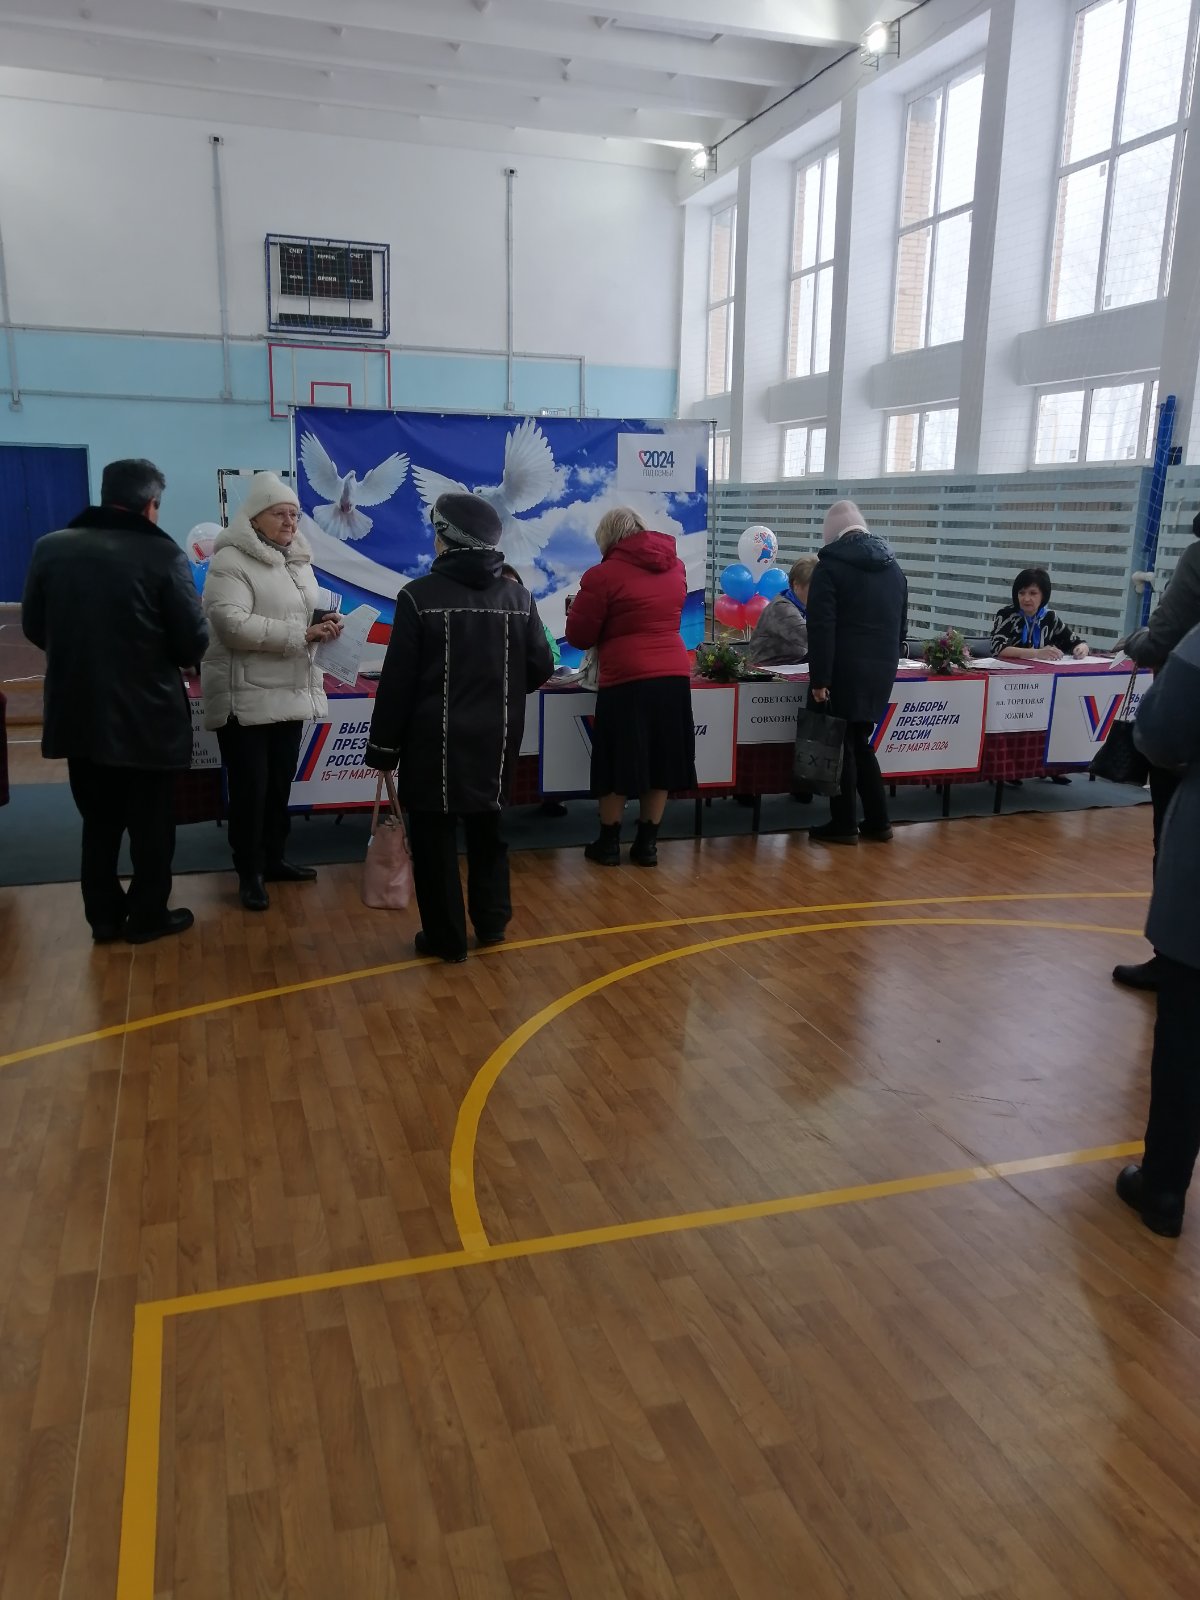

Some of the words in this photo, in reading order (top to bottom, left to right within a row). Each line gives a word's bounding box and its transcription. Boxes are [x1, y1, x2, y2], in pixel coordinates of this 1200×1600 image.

[643, 450, 675, 469] 2024
[1004, 683, 1039, 691] СТЕПНАЯ
[751, 695, 803, 704] СОВЕТСКАЯ
[1007, 697, 1045, 706] ТОРГОВАЯ
[902, 701, 948, 713] ВЫБОРЫ
[750, 714, 797, 724] СОВХОЗНА
[896, 714, 960, 727] ПРЕЗИДЕНТА
[1004, 711, 1034, 720] ЮЖНАЯ
[339, 722, 370, 734] ВЫБ
[890, 729, 932, 740] РОССИИ
[906, 742, 931, 752] МАРТА
[931, 741, 949, 751] 2024
[326, 754, 365, 767] РОСС
